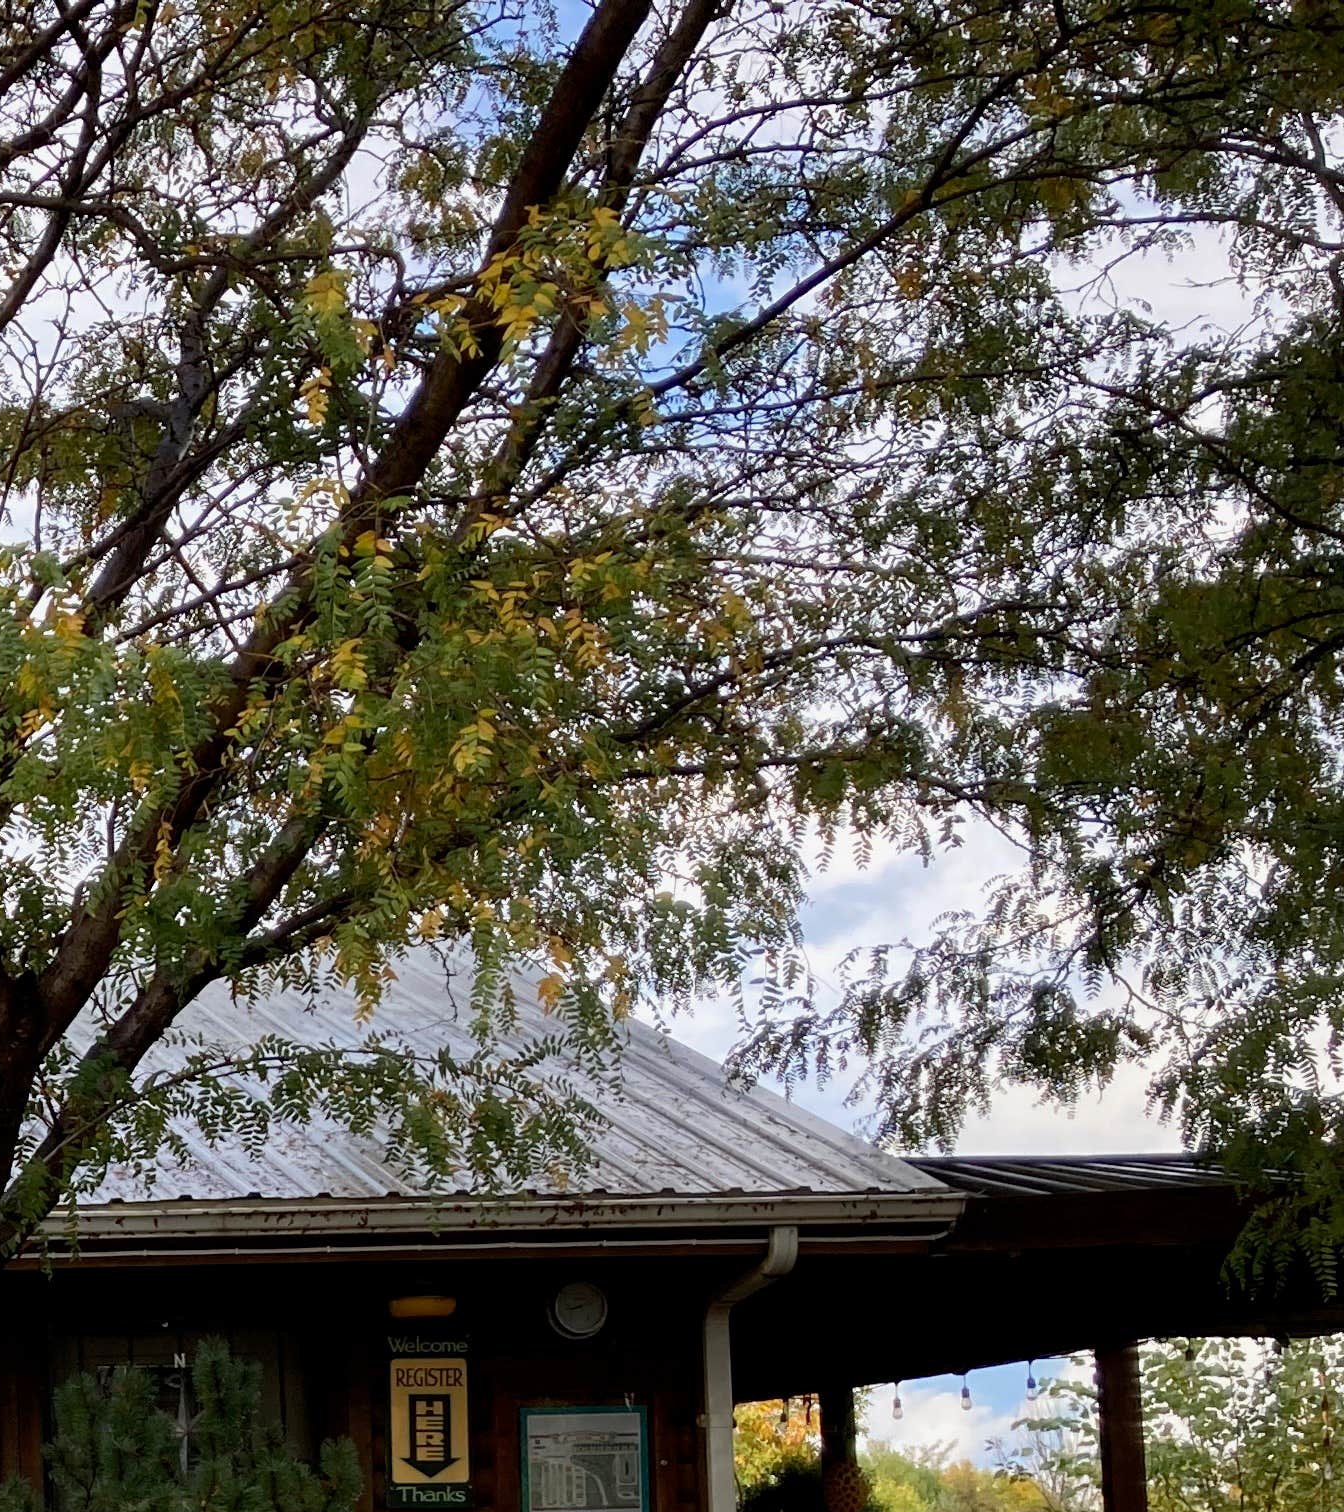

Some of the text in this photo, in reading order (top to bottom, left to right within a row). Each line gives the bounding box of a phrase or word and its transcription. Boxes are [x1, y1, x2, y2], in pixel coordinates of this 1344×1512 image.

[387, 1336, 468, 1354] Welcome
[173, 1352, 186, 1369] N
[396, 1367, 463, 1388] REGISTER
[415, 1400, 445, 1462] HERE
[396, 1485, 467, 1503] Thanks
